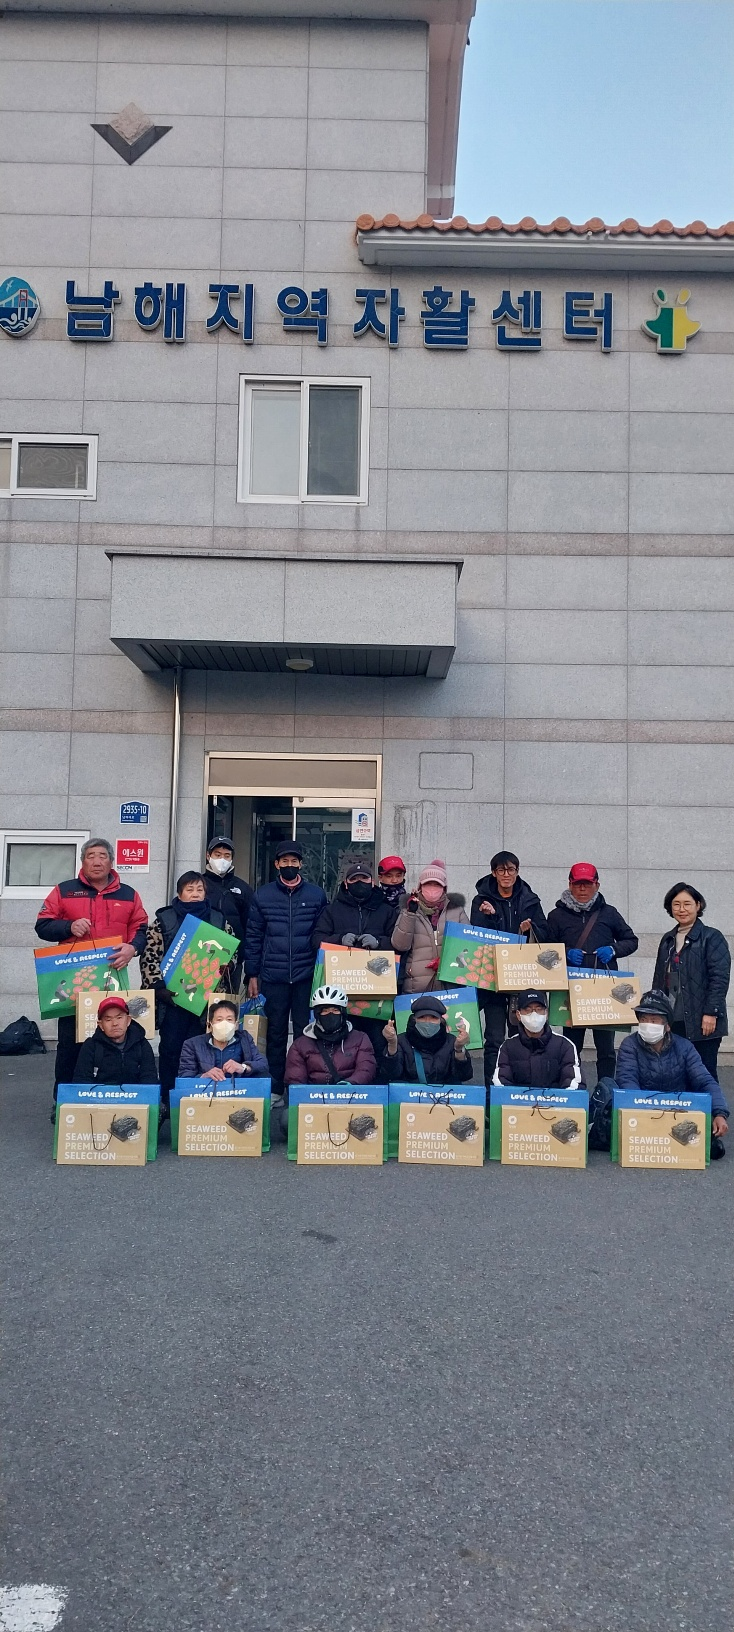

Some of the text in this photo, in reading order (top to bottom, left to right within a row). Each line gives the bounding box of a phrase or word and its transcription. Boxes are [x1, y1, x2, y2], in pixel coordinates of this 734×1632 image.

[65, 279, 614, 352] 남해지역자활센터
[122, 805, 147, 814] 2935-10
[122, 848, 144, 858] 에스원
[485, 934, 510, 942] RESPECT
[172, 932, 186, 958] RESPECT
[79, 953, 107, 961] RESPECT
[216, 1089, 247, 1097] RESPECT
[406, 1132, 448, 1140] SEAWEED
[509, 1134, 550, 1142] SEAWEED
[406, 1141, 448, 1149] PREMIUM
[509, 1143, 550, 1152] PREMIUM
[629, 1146, 671, 1154] PREMIUM
[65, 1152, 116, 1160] SELECTION
[406, 1150, 455, 1159] SELECTION
[508, 1152, 558, 1161] SELECTION
[629, 1155, 678, 1163] SELECTION
